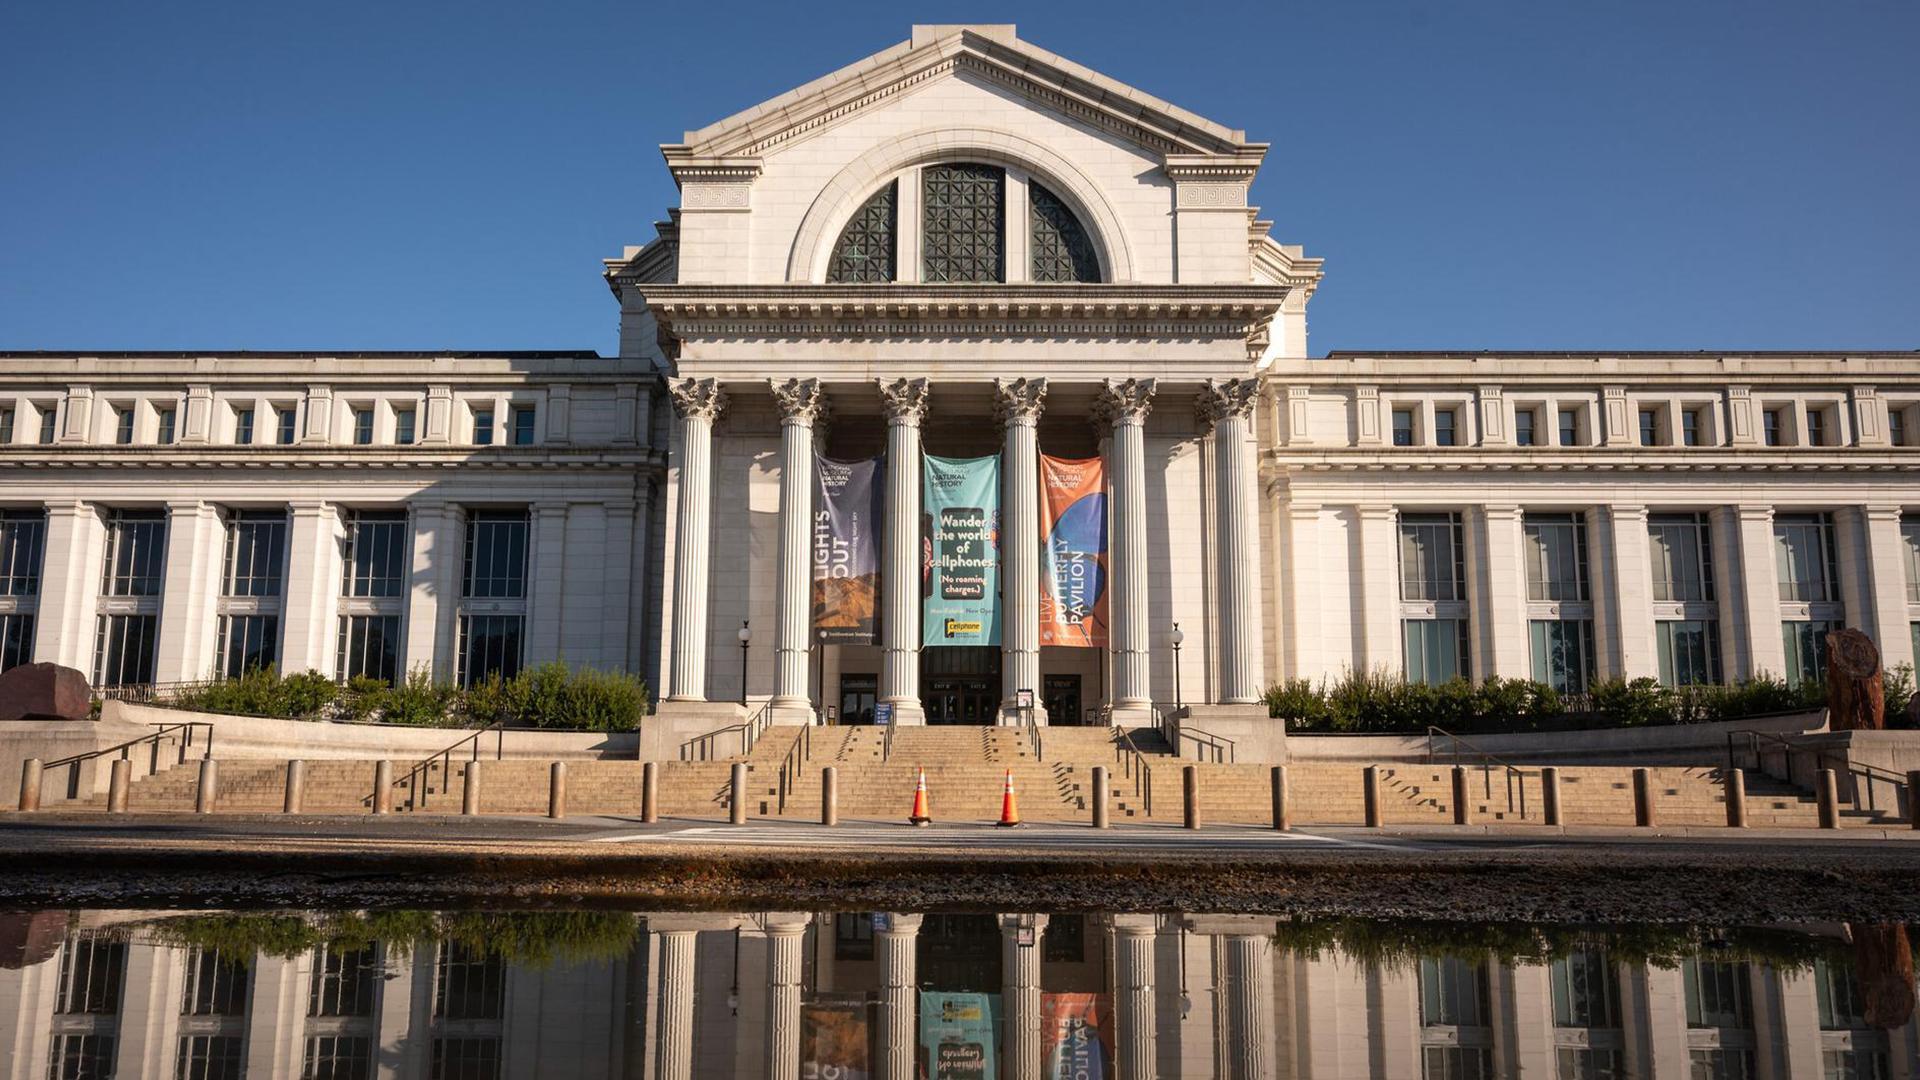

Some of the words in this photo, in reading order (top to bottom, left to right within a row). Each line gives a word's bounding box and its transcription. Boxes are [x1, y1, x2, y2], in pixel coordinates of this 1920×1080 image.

[941, 515, 987, 528] Wander
[934, 528, 955, 541] the
[957, 528, 991, 541] world
[814, 510, 830, 580] LIGHTS
[956, 541, 971, 554] of
[833, 537, 849, 579] OUT
[938, 575, 954, 584] (No
[955, 575, 988, 587] roaming
[1055, 537, 1069, 625] BUTTERFLY
[945, 584, 981, 596] charges.)
[1071, 551, 1085, 625] PAVILION
